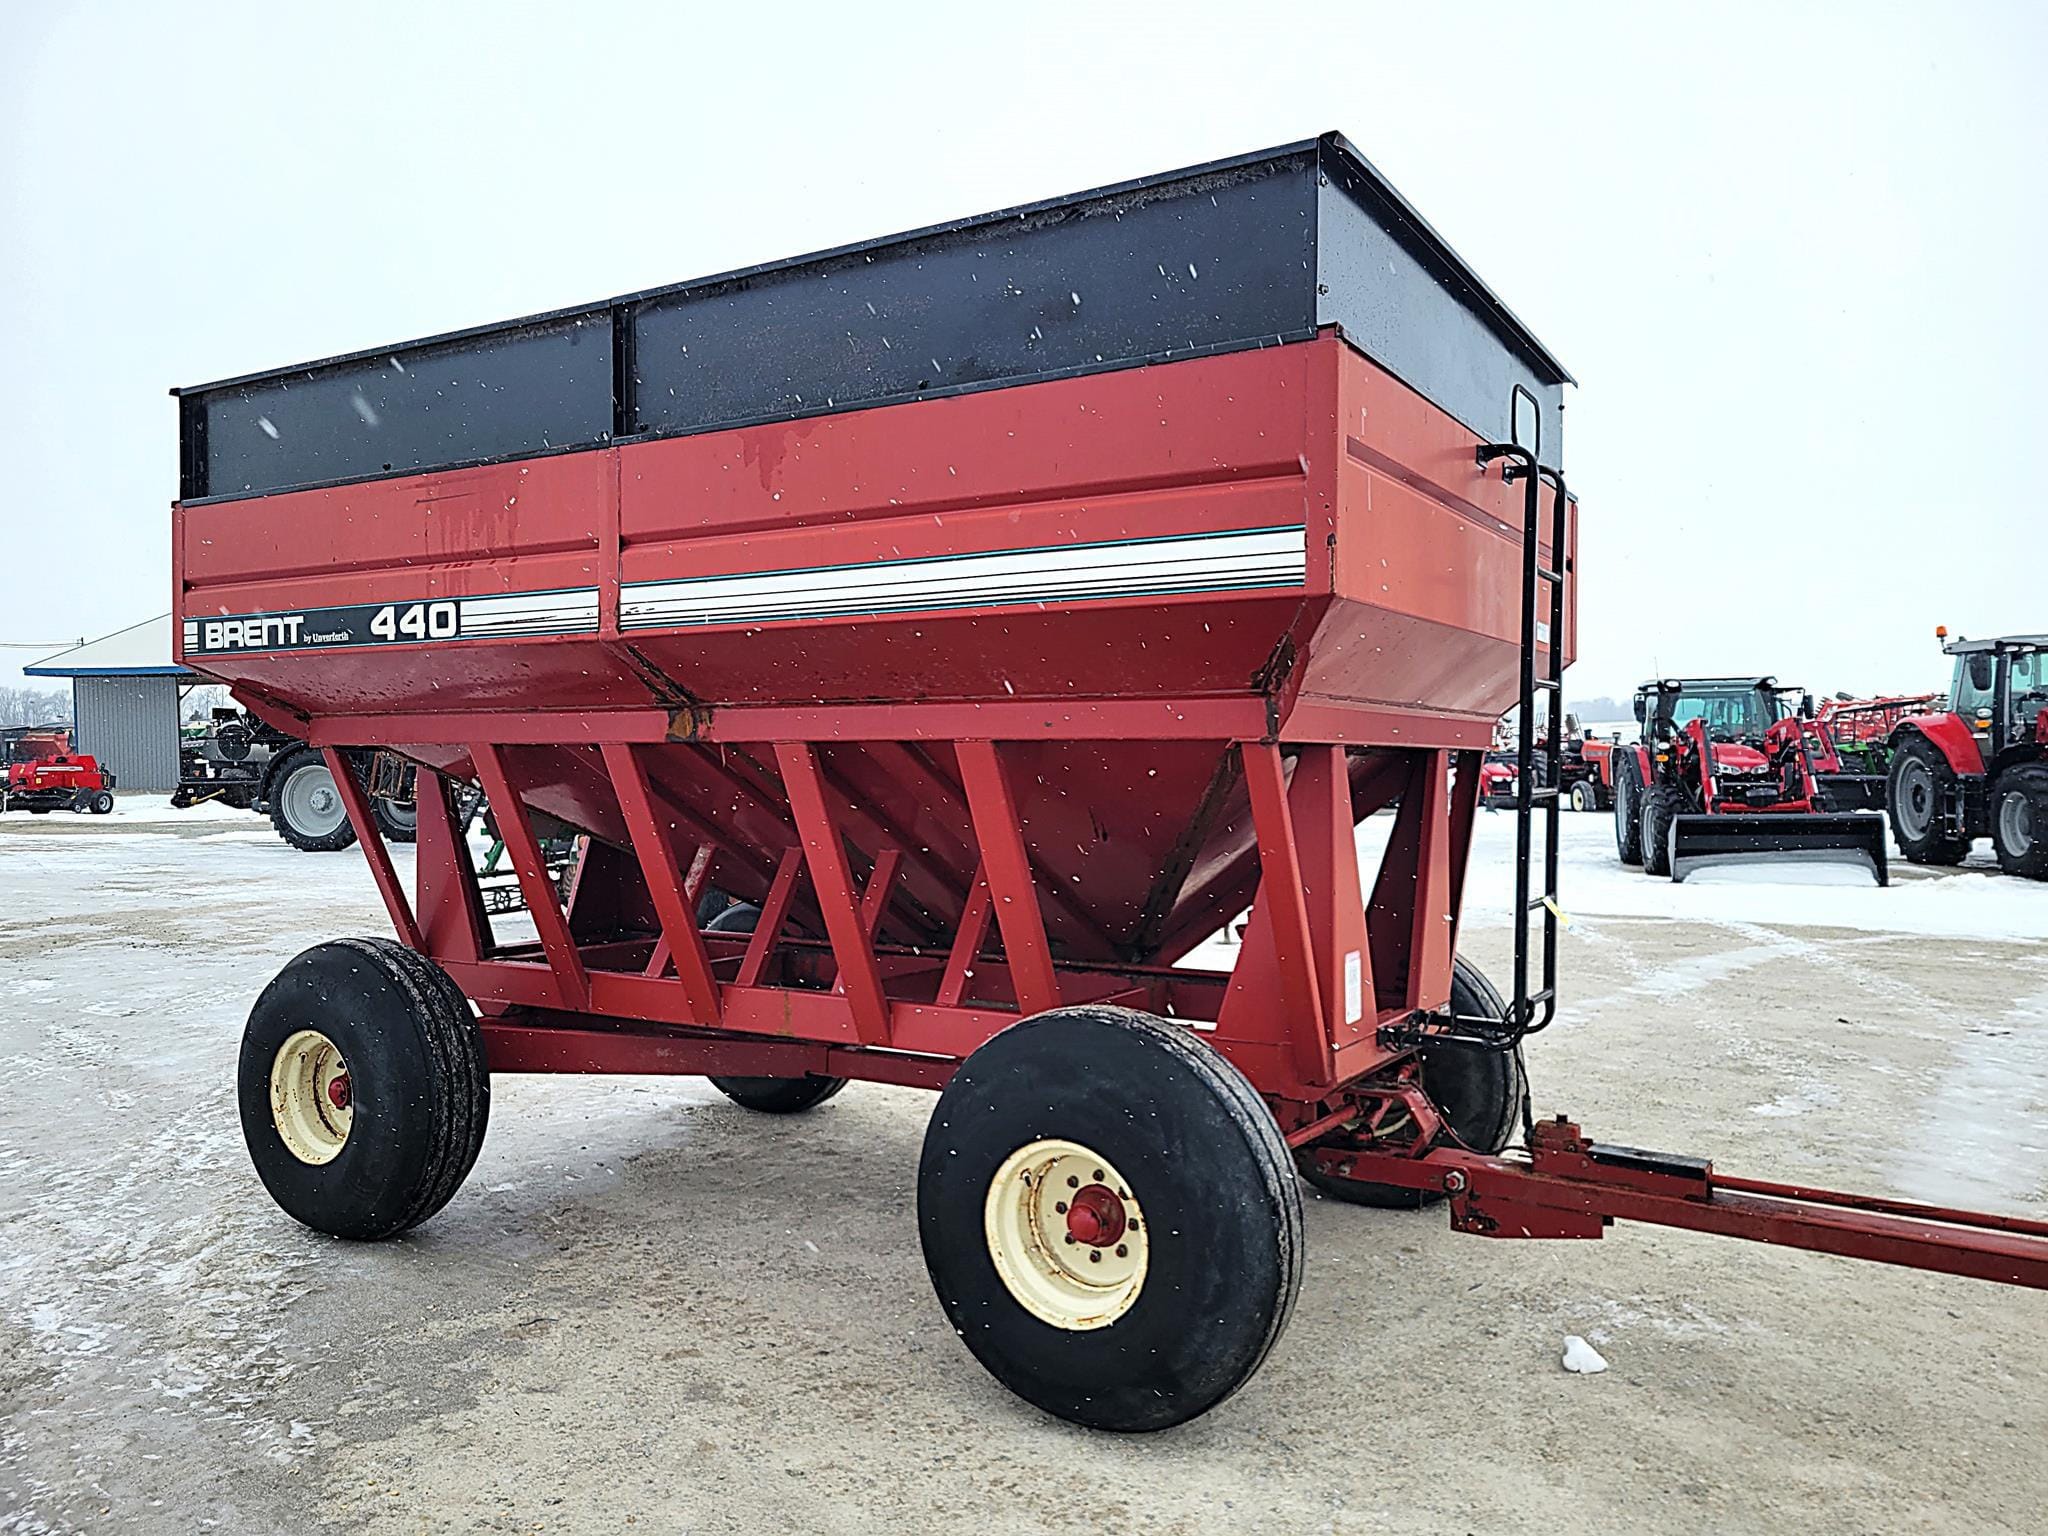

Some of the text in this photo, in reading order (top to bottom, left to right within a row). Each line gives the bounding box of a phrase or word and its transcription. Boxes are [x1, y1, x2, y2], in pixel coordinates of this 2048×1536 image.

[205, 616, 304, 650] BRENT
[370, 602, 457, 641] 440
[303, 633, 312, 645] by
